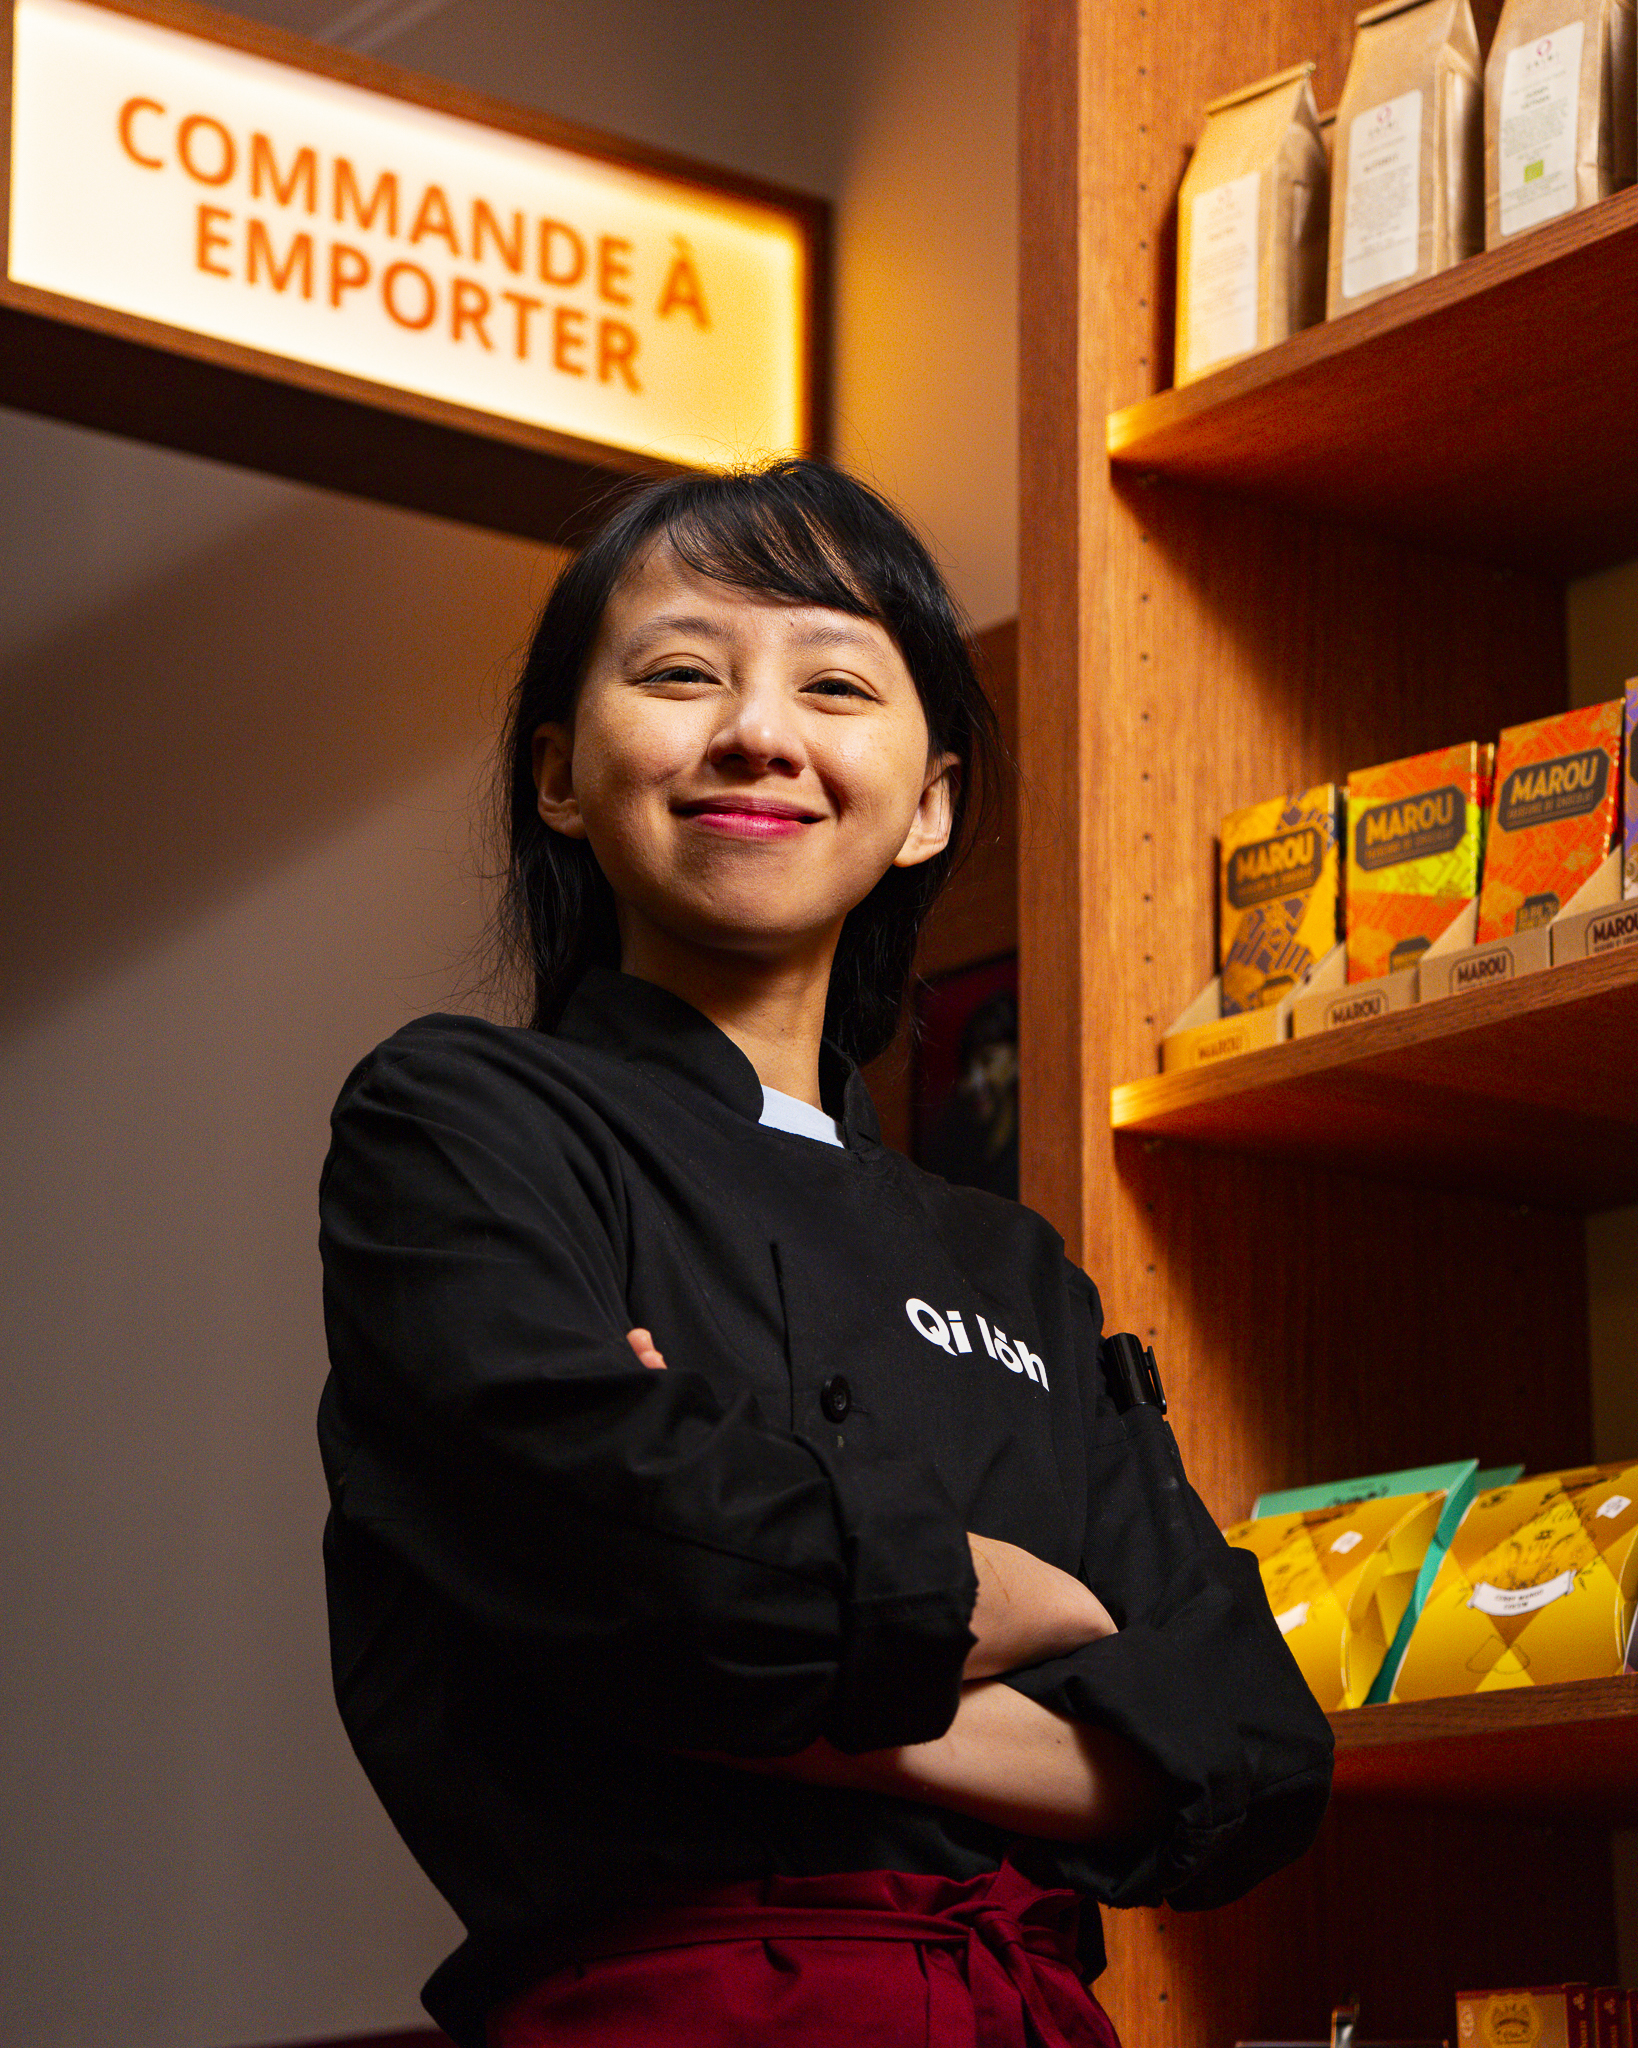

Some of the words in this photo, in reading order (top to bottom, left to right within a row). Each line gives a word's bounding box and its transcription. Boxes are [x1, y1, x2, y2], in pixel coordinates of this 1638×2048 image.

[118, 97, 636, 303] COMMANDE
[656, 236, 711, 331] À
[195, 204, 642, 392] EMPORTER
[1510, 755, 1599, 806] MAROU
[1365, 793, 1453, 846] MAROU
[1236, 831, 1314, 883] MAROU
[1457, 954, 1506, 987] MAROU
[906, 1298, 973, 1356] Qi
